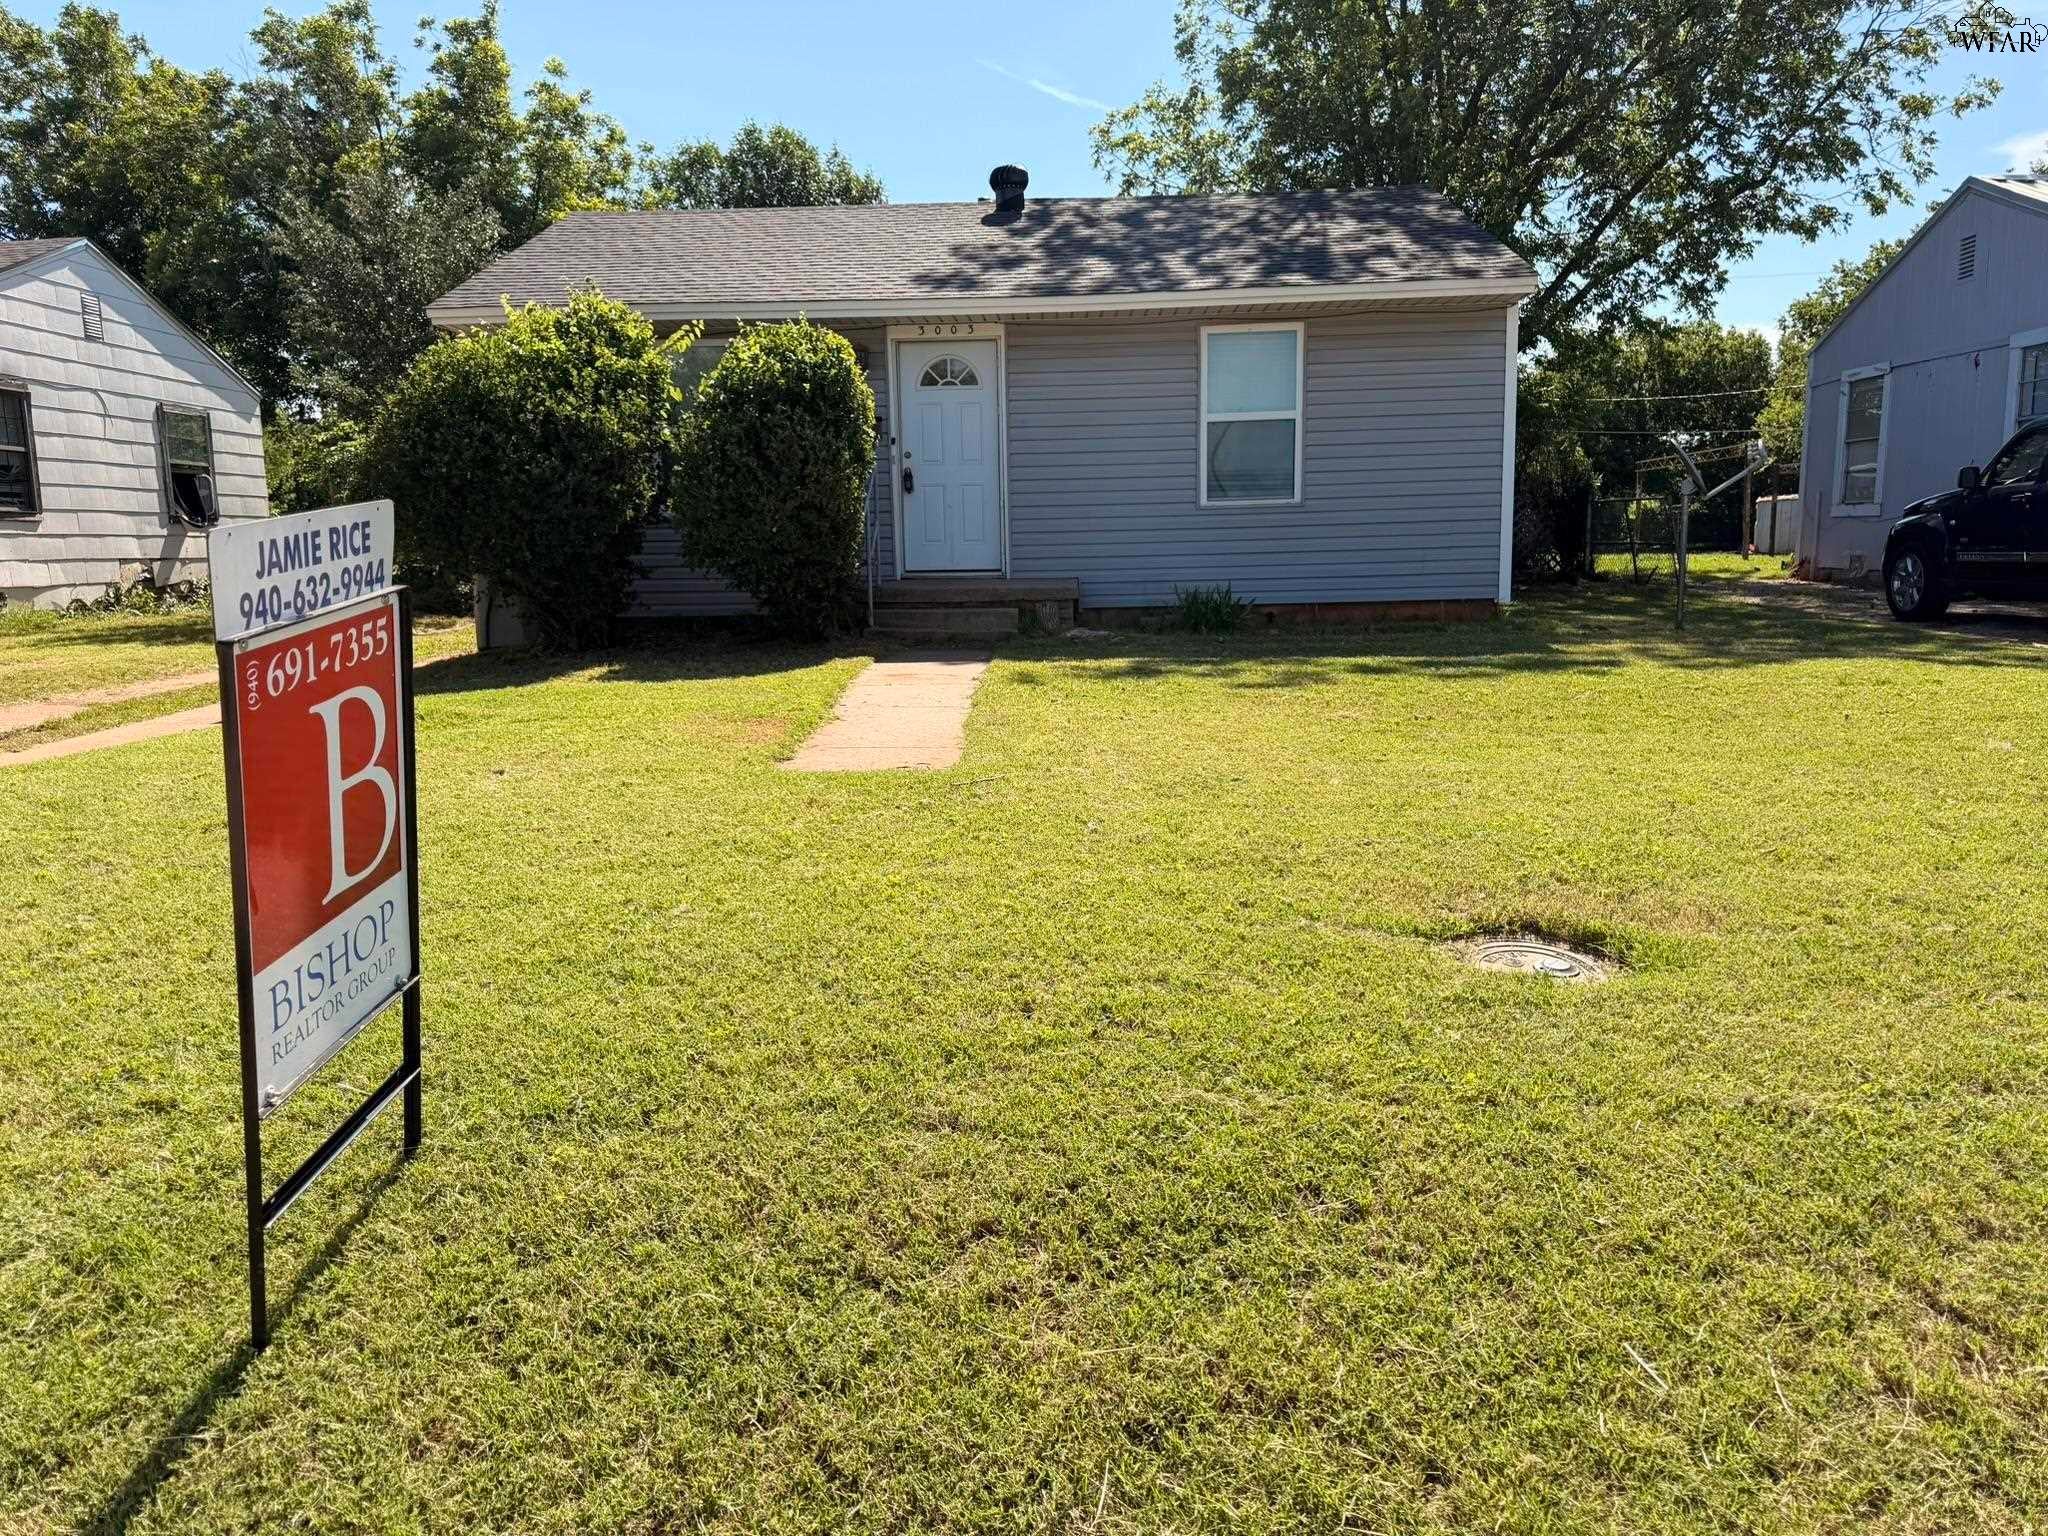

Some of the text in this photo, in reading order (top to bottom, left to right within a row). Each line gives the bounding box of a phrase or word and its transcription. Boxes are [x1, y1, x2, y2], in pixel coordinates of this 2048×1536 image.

[918, 325, 974, 336] 3003
[239, 558, 386, 631] 940-632-9944
[255, 520, 371, 580] JAMIE RICE
[246, 616, 389, 711] (940) 691-7355
[308, 685, 397, 906] B
[268, 899, 394, 1035] BISHOP
[271, 947, 396, 1066] REALTOR GROUP
